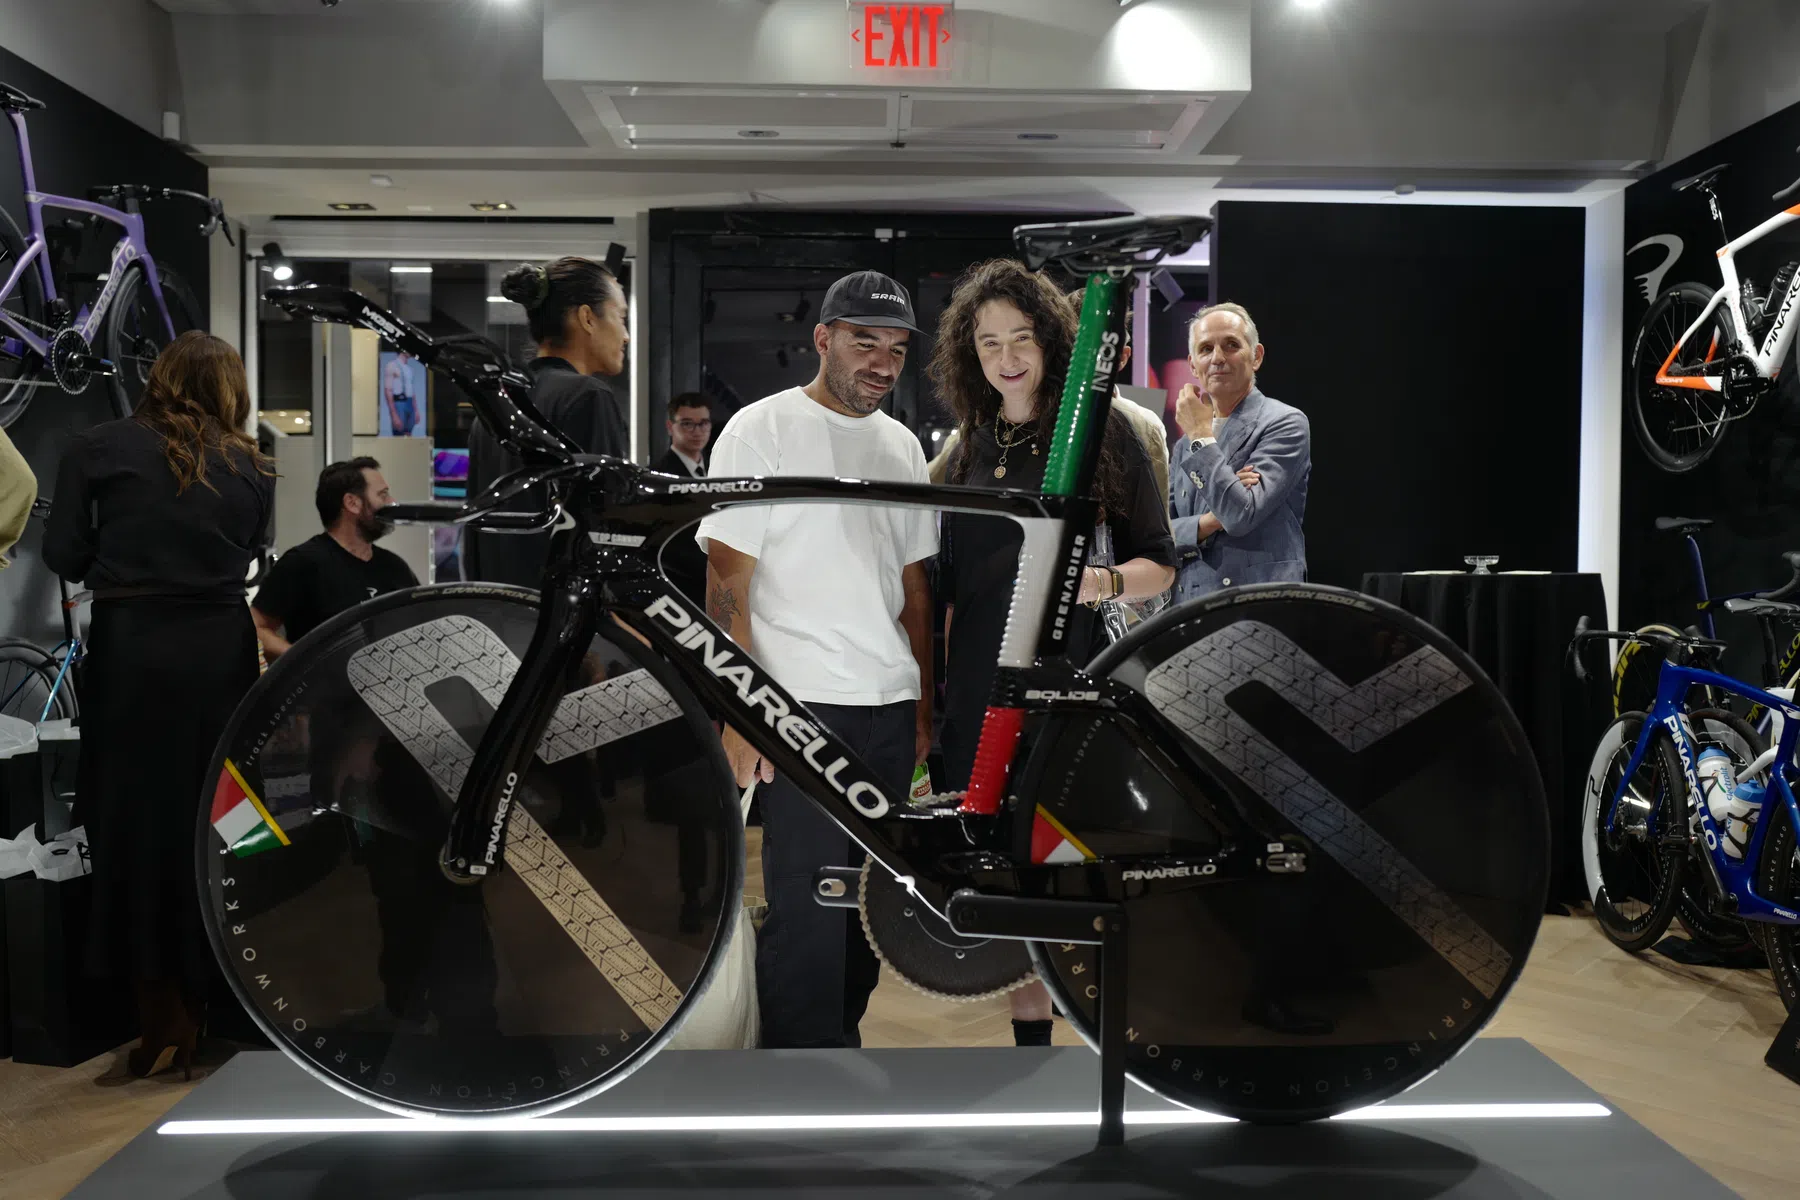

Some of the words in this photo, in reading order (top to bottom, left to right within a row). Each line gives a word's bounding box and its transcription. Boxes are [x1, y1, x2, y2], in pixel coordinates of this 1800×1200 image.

[865, 6, 944, 67] EXIT
[88, 245, 136, 337] PINARELLO
[870, 293, 905, 305] SRAM
[1764, 271, 1800, 357] PINARE
[1091, 331, 1120, 393] INEOS
[668, 481, 764, 494] PINARELLO
[1052, 534, 1086, 641] GRENADIER
[644, 595, 890, 820] PINARELLO
[1025, 689, 1100, 701] BOLIDE
[484, 771, 518, 865] PINARELLO
[1663, 715, 1717, 851] PINARELLO
[1122, 864, 1217, 881] PINARELLO
[222, 875, 397, 1086] CARBONWORKS
[1060, 942, 1256, 1095] CARBONORK
[429, 1029, 631, 1099] PRINCETON
[1287, 997, 1473, 1096] PRINCETON
